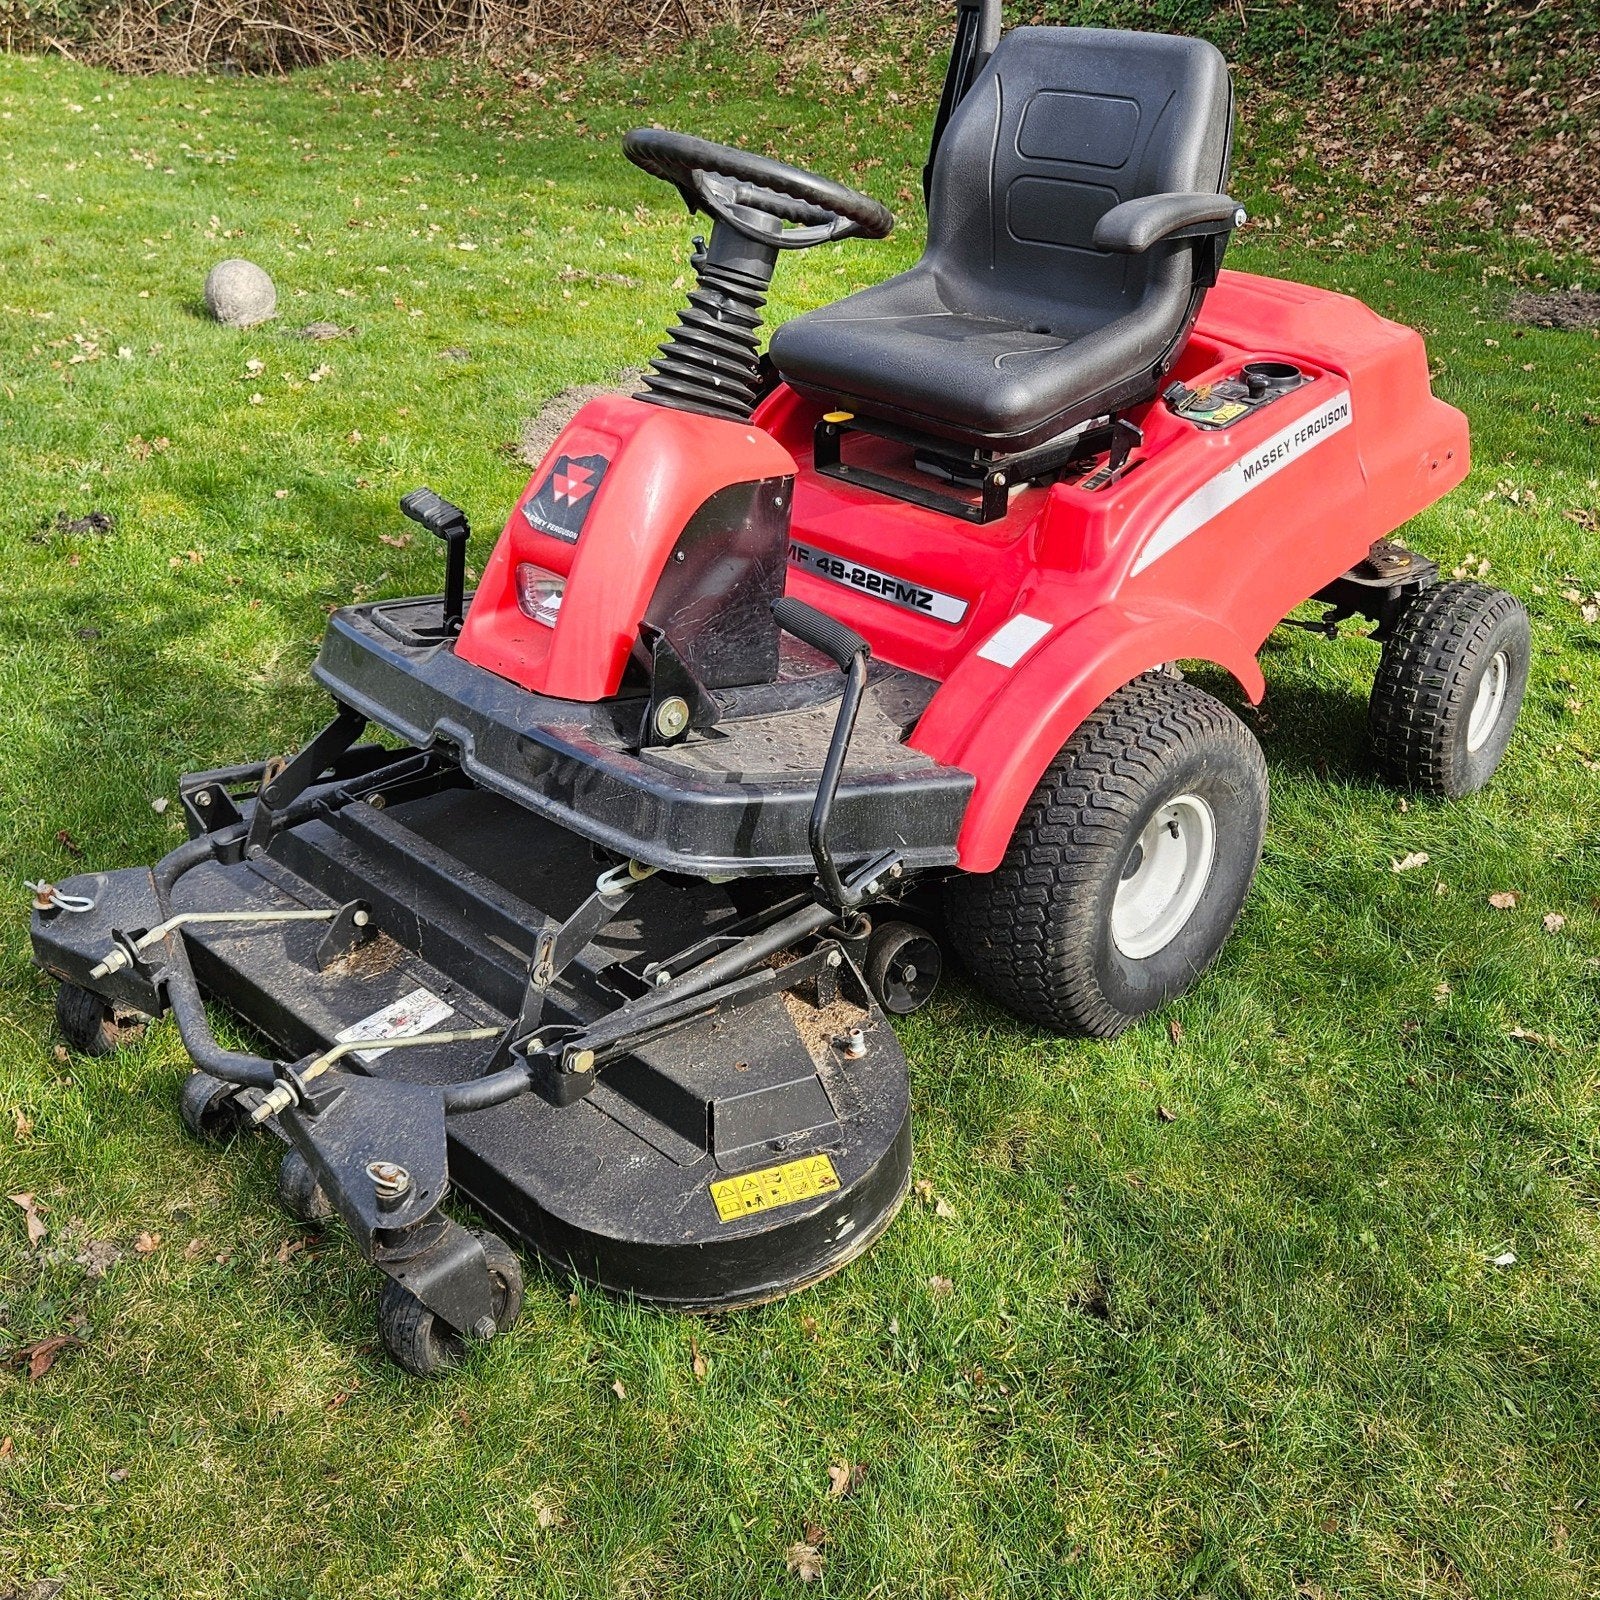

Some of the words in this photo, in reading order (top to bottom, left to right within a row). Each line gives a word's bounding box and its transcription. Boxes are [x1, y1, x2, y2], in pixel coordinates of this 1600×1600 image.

[1243, 438, 1290, 482] MASSEY
[1294, 403, 1348, 446] FERGUSON
[546, 522, 579, 540] FERGUSON
[816, 557, 934, 611] 48-22FMZ
